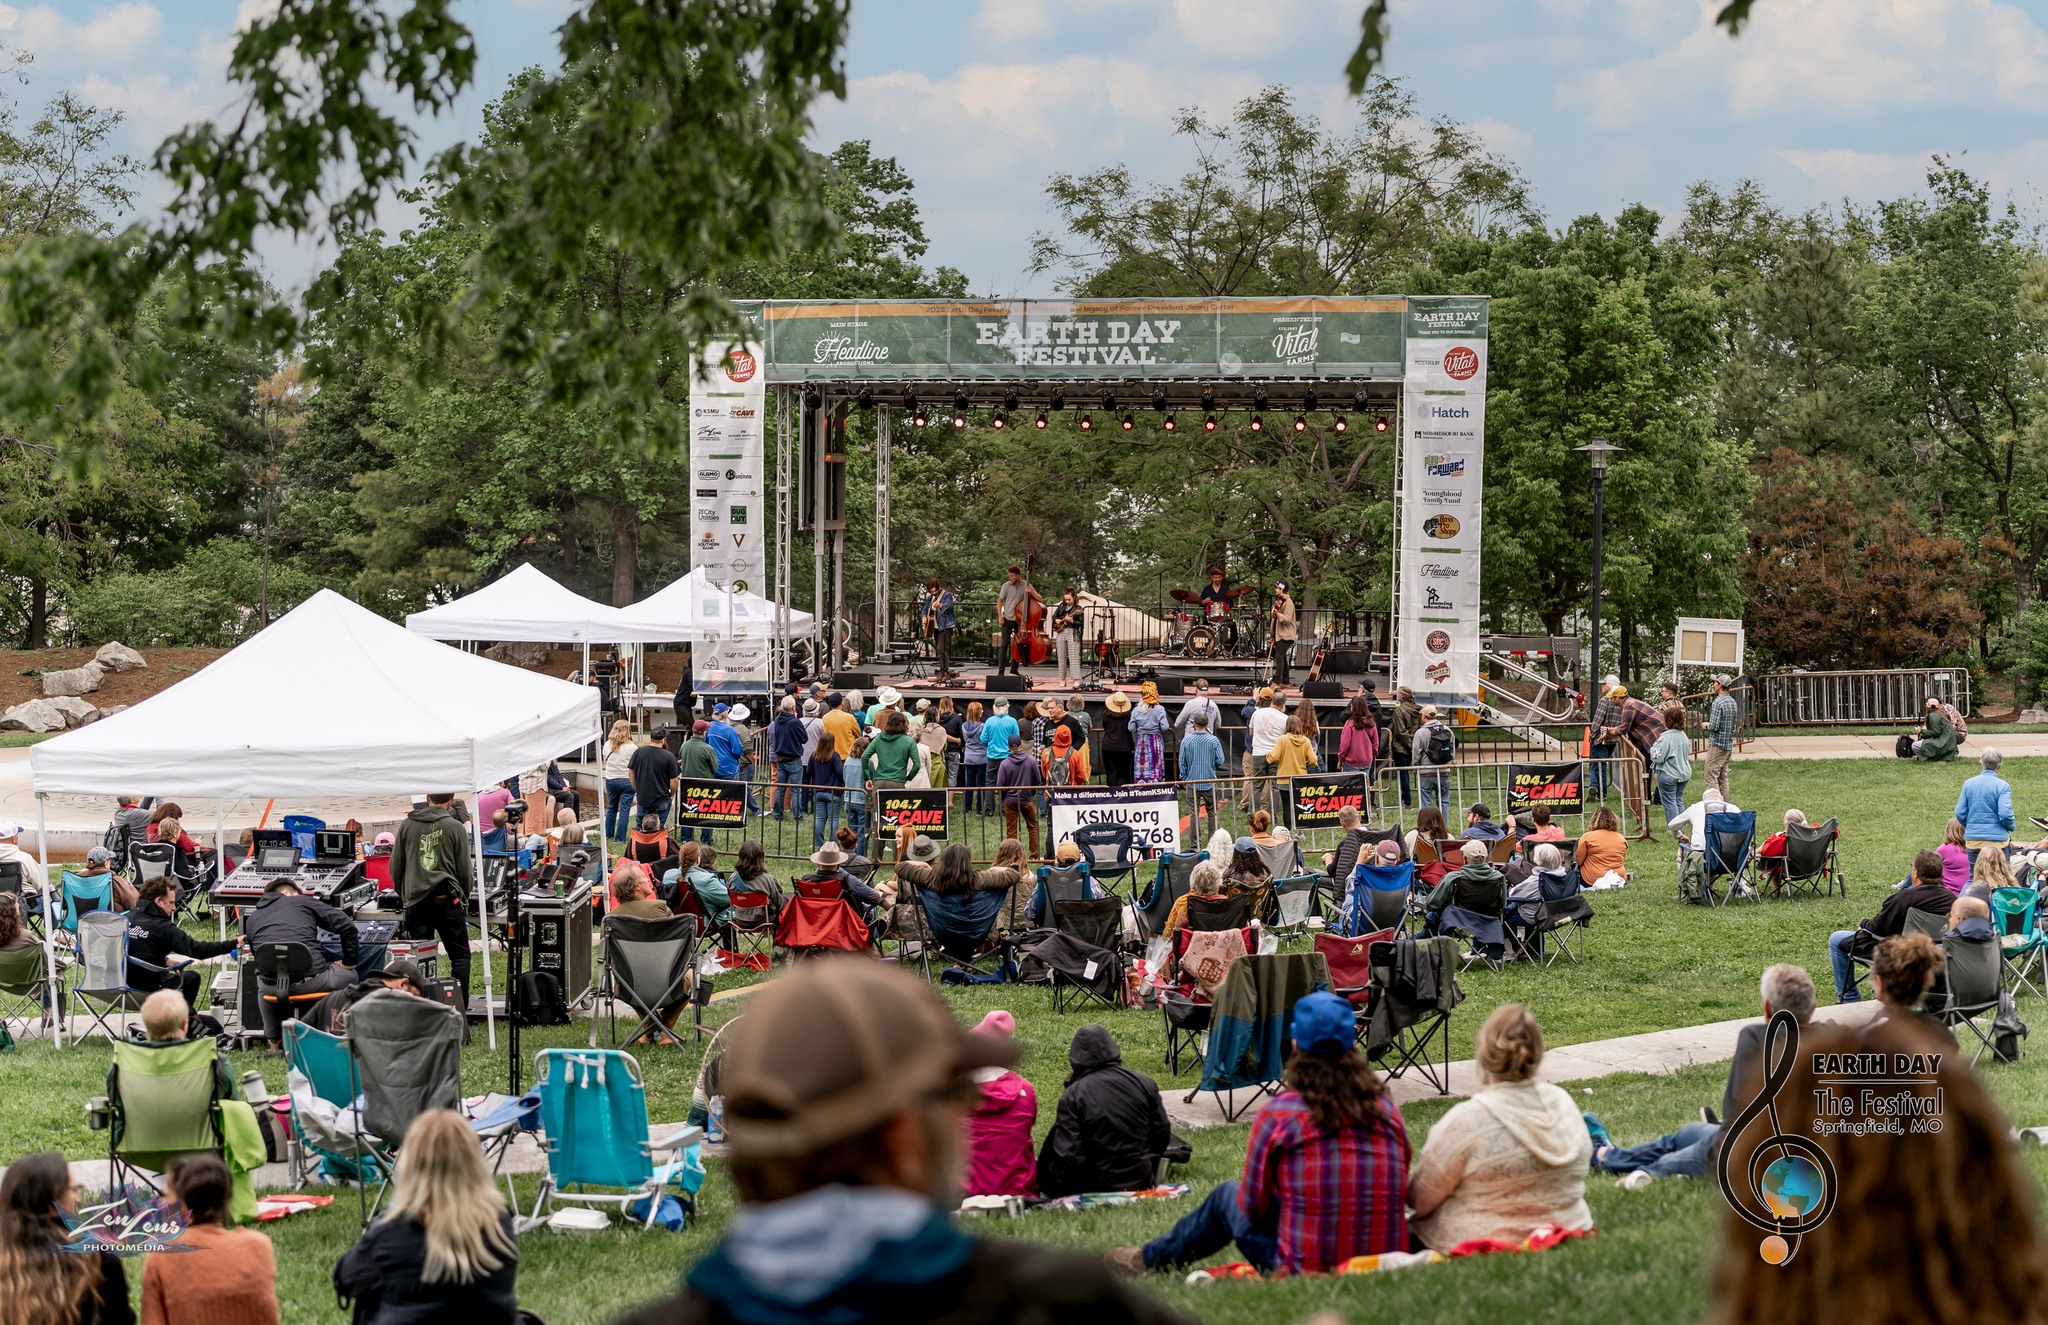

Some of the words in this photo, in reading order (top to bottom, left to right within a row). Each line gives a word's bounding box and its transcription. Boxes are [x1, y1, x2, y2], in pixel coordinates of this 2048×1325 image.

[968, 306, 983, 314] Day
[1084, 305, 1108, 313] legacy
[1186, 304, 1209, 312] Jimmy
[1413, 312, 1454, 322] EARTH
[1455, 311, 1480, 321] DAY
[1428, 320, 1466, 328] FESTIVAL
[976, 321, 1099, 345] EARTH
[1107, 320, 1181, 344] DAY
[1272, 324, 1319, 358] Vital
[814, 337, 889, 363] Headline
[1015, 346, 1156, 366] FESTIVAL
[1445, 351, 1474, 372] Vital
[1432, 406, 1469, 418] Hatch
[1423, 490, 1462, 498] Youngblood
[1440, 515, 1453, 523] Bass
[1439, 528, 1457, 536] Shops
[732, 534, 746, 548] V
[1420, 564, 1459, 577] Headline
[1515, 774, 1555, 786] 104.7
[686, 787, 721, 799] 104.7
[1078, 791, 1112, 799] difference.
[1113, 789, 1128, 797] Join
[1129, 787, 1175, 797] #TeamKSMU.
[1300, 785, 1338, 797] 104.7
[1515, 785, 1530, 793] The
[1529, 782, 1579, 799] CAVE
[698, 798, 742, 815] CAVE
[885, 799, 922, 810] 104.7
[1300, 797, 1315, 805] The
[1315, 795, 1363, 812] CAVE
[898, 810, 944, 825] CAVE
[1076, 808, 1159, 826] KSMU.org
